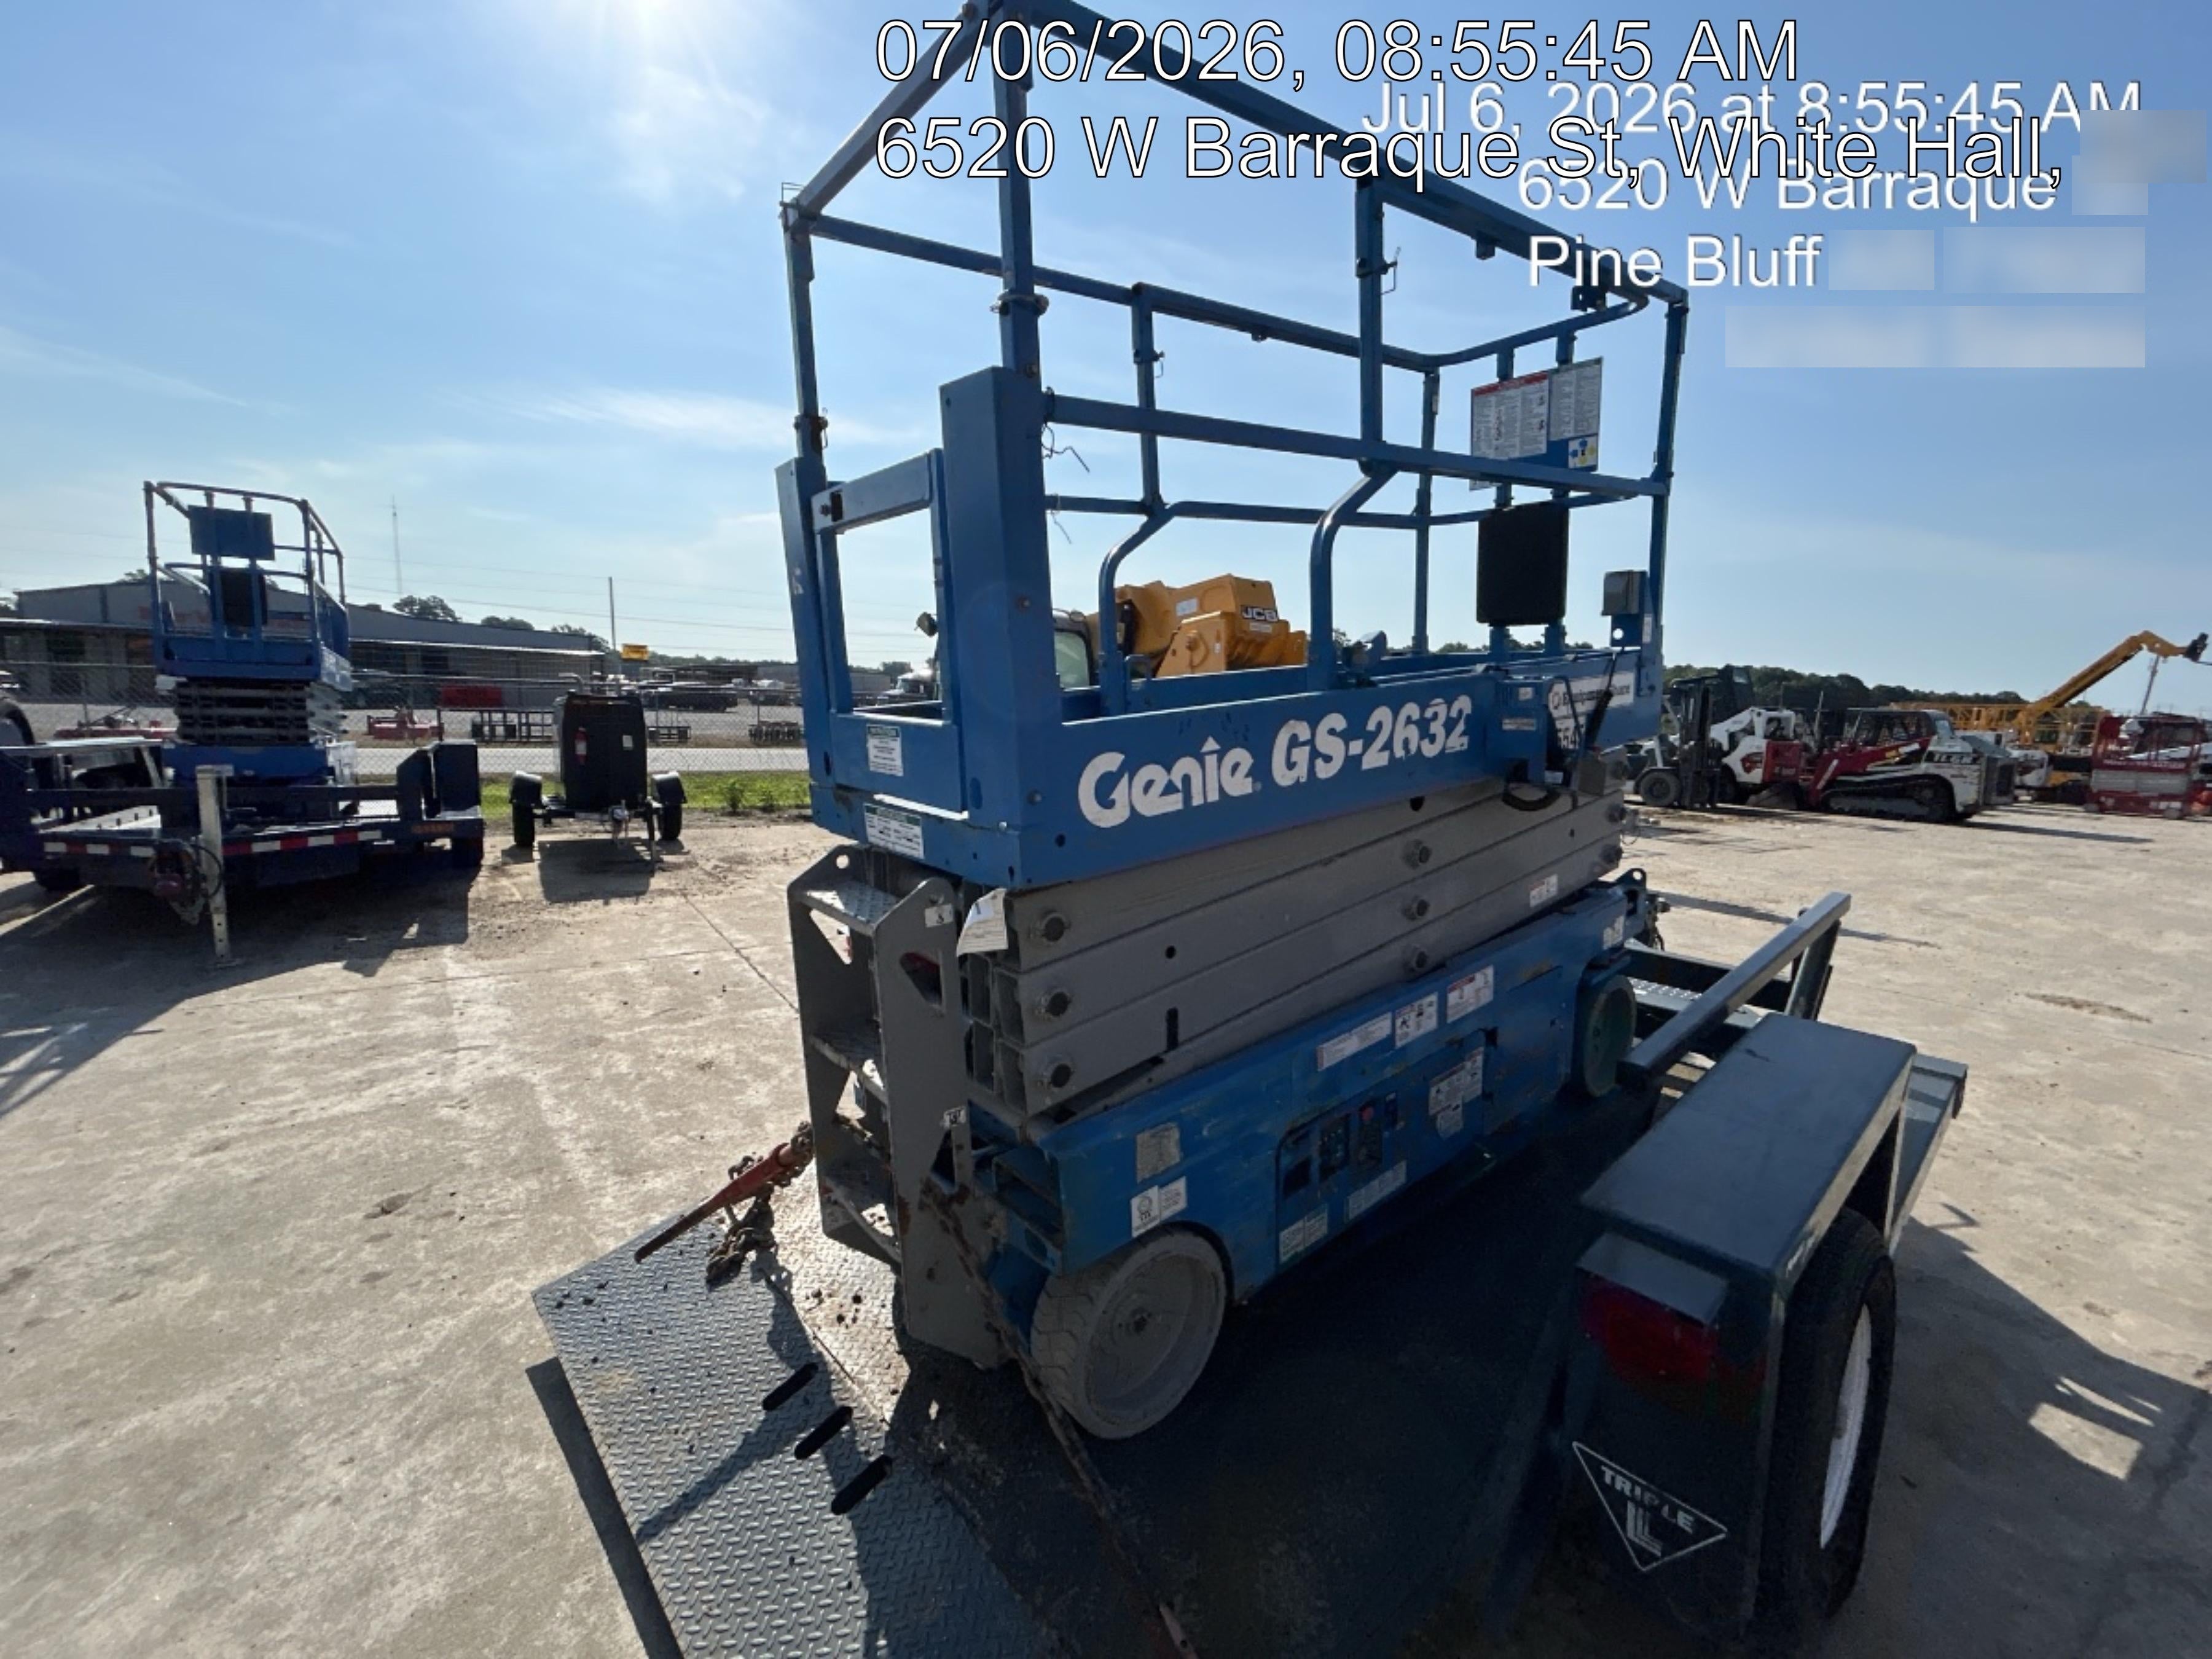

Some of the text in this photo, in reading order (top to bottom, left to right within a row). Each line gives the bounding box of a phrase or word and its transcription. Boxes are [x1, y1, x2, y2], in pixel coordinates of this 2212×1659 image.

[1242, 607, 1277, 622] JCB
[1077, 694, 1472, 828] Genie GS-2632
[1601, 1464, 1695, 1534] TRIPLE
